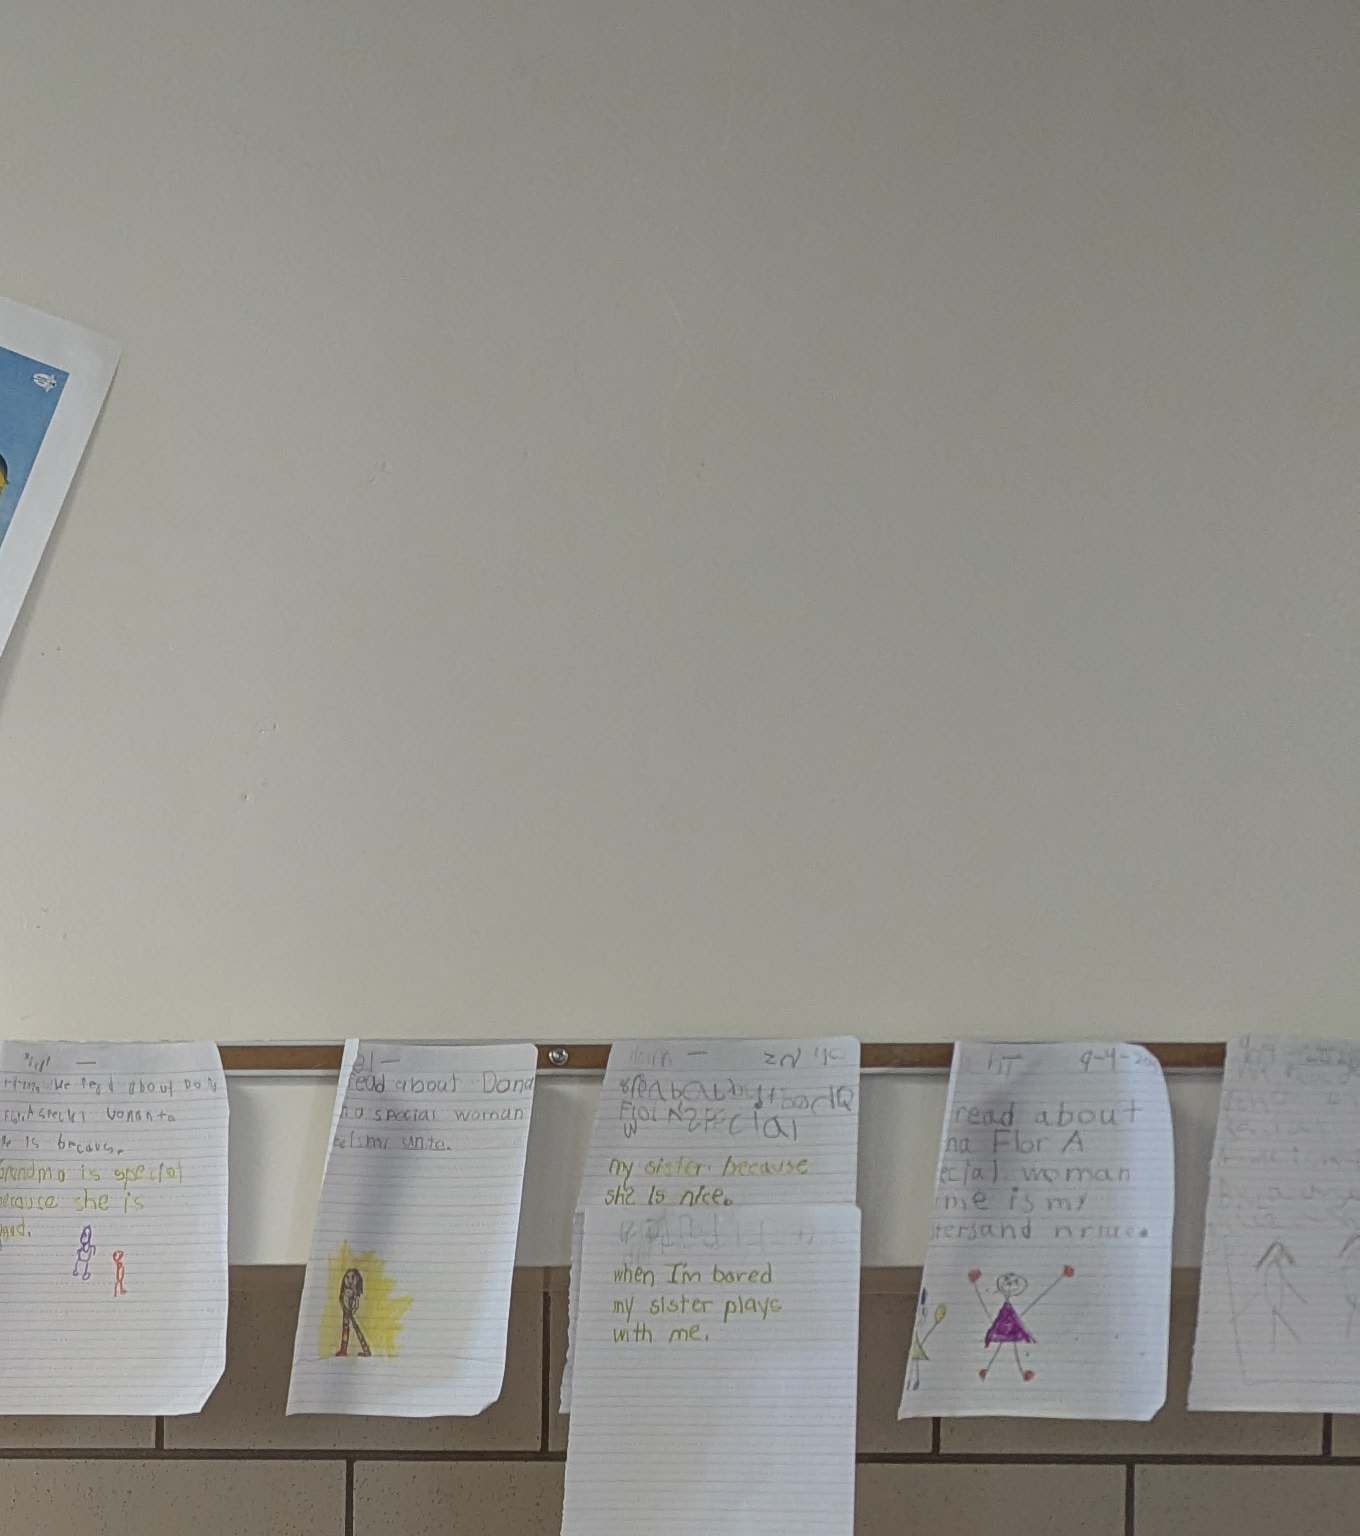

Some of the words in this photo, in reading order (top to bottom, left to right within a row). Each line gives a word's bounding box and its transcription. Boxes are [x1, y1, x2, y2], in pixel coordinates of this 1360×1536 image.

[1062, 1130, 1083, 1153] A
[614, 1264, 654, 1287] when
[665, 1262, 701, 1284] I'm
[713, 1264, 772, 1284] bored
[613, 1297, 634, 1322] my
[650, 1298, 713, 1314] sister
[724, 1298, 782, 1323] plays
[613, 1322, 652, 1343] with
[669, 1325, 710, 1343] me.
